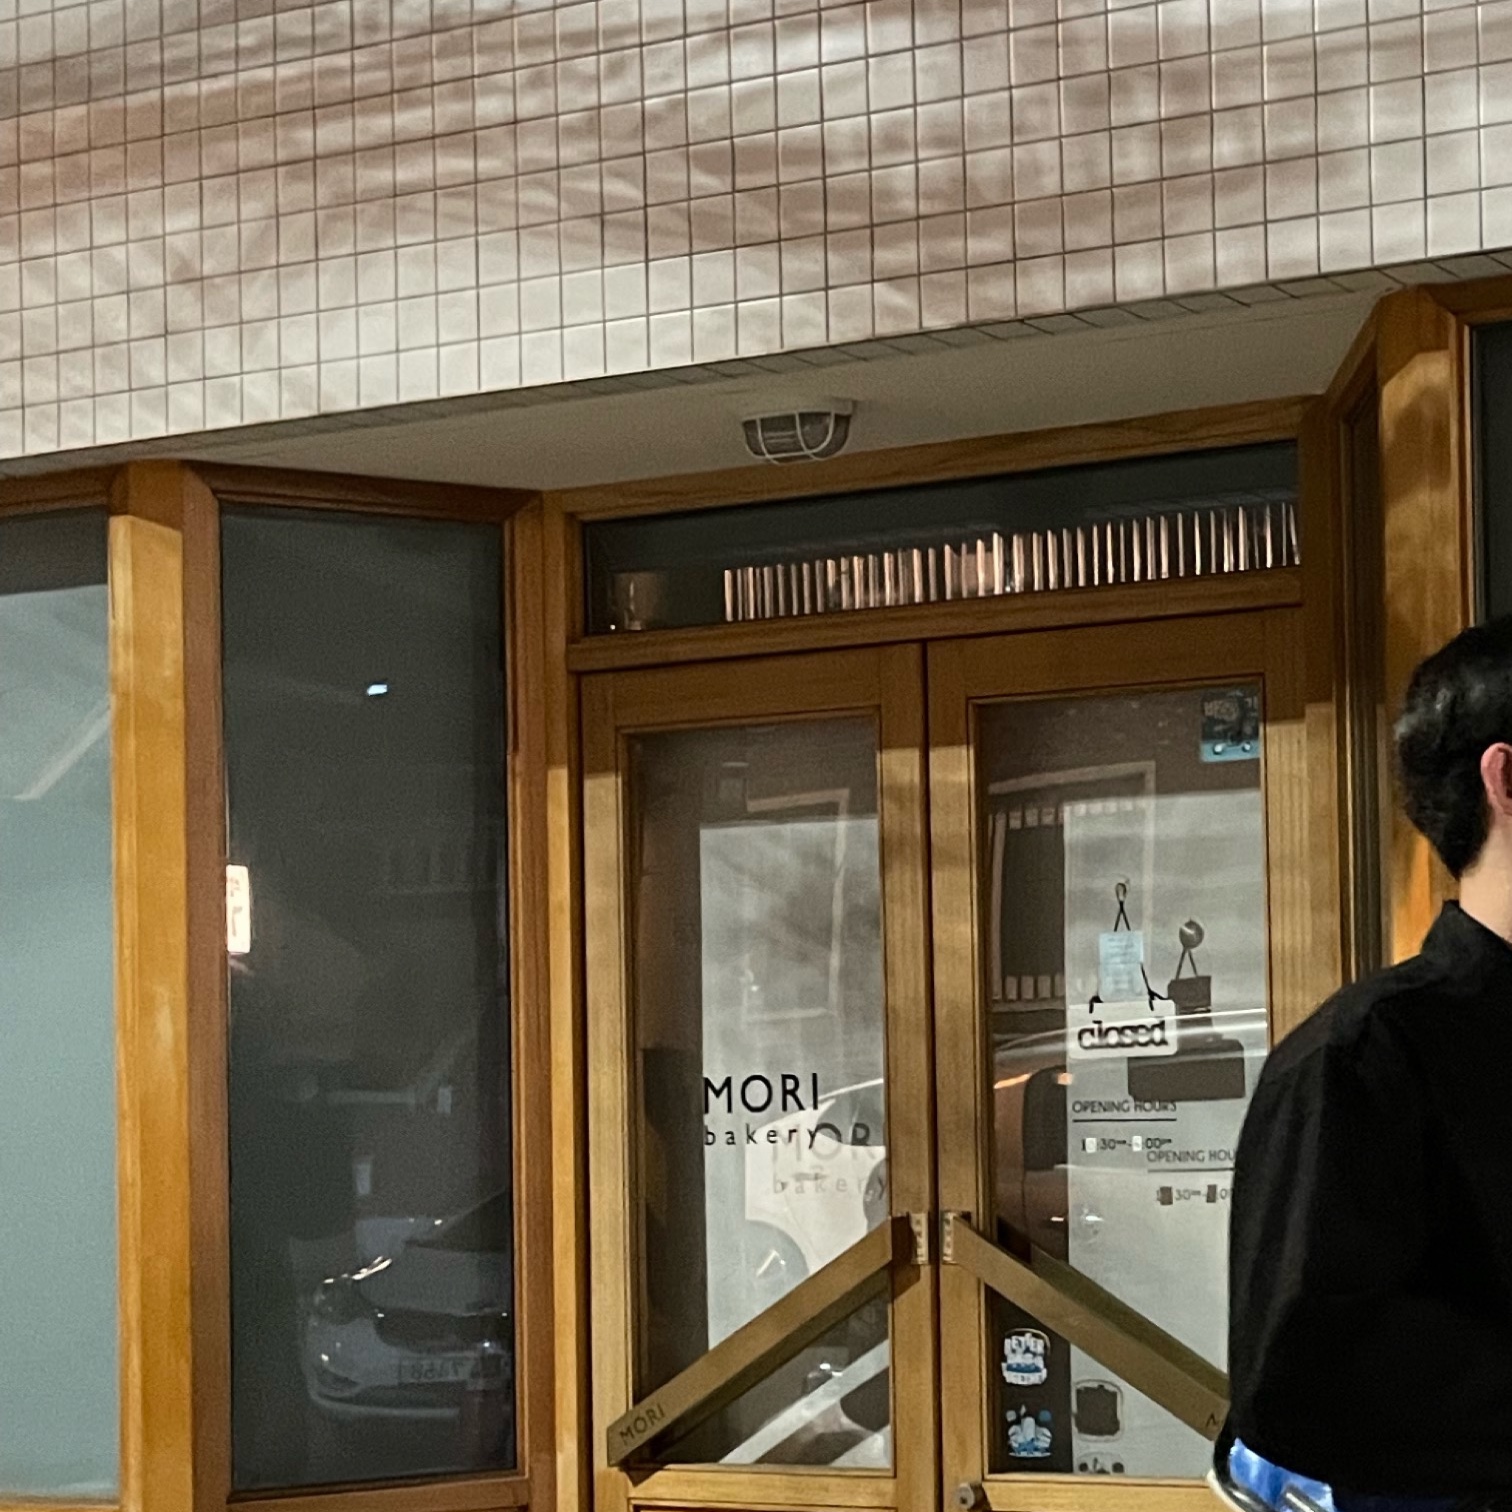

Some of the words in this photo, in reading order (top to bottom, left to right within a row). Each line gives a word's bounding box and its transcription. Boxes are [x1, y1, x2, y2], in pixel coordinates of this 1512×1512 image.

[1078, 1020, 1168, 1050] closed
[703, 1072, 819, 1114] MORI
[1071, 1100, 1131, 1114] OPENING
[1133, 1100, 1178, 1114] HOURS
[703, 1122, 817, 1150] bakery
[1147, 1150, 1206, 1163] OPENING
[1208, 1149, 1236, 1162] HOU
[618, 1403, 666, 1447] MORI
